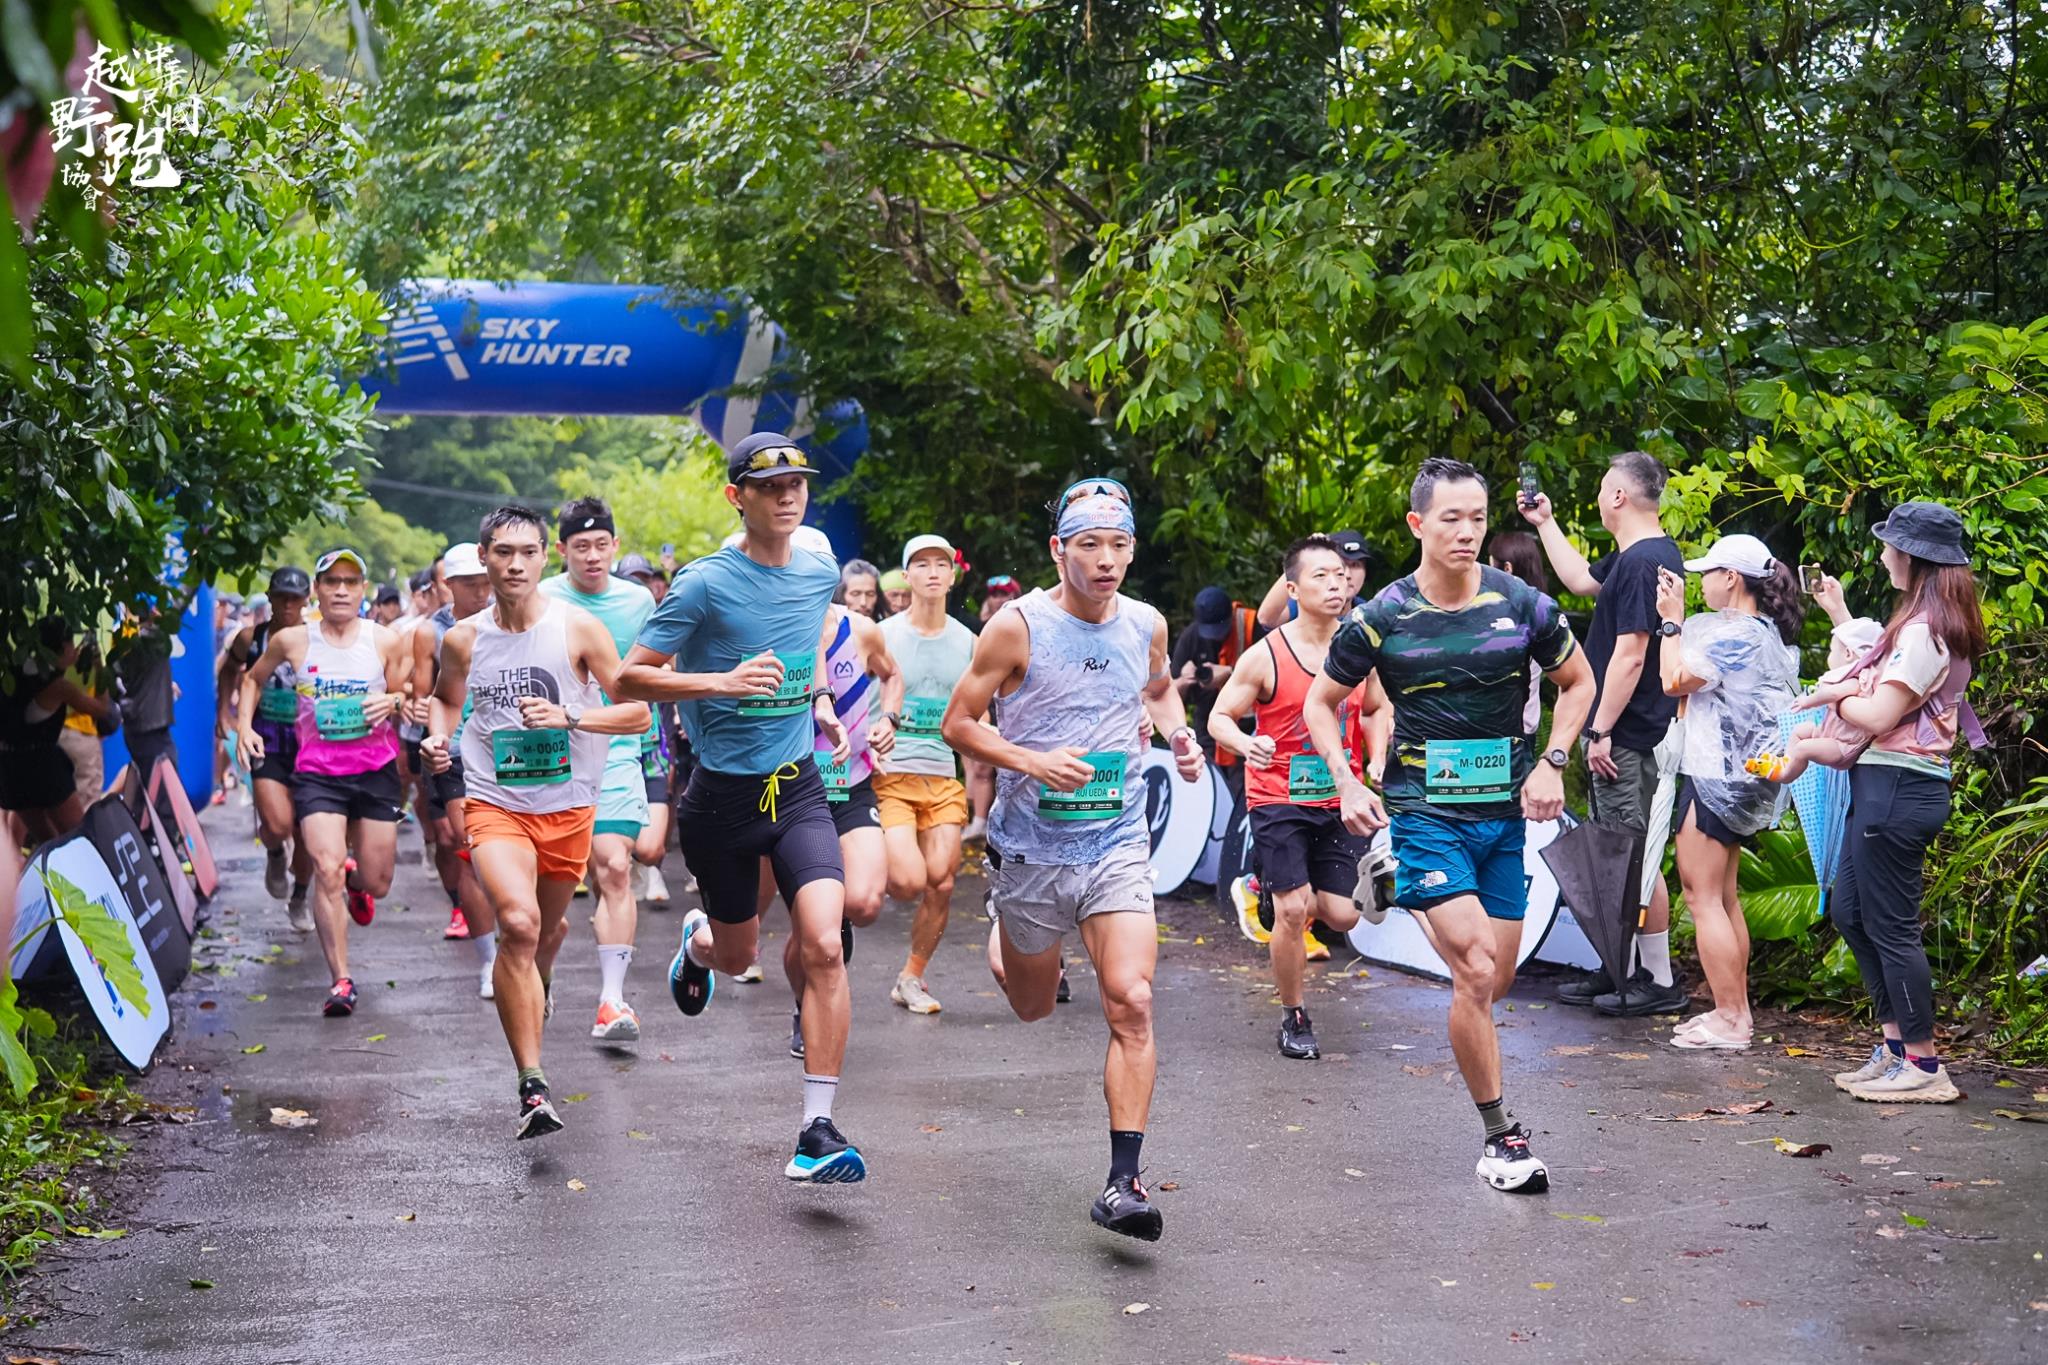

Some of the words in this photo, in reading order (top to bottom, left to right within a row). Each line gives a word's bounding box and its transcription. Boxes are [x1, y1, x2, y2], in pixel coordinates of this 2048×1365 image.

[480, 317, 560, 340] SKY
[480, 342, 631, 367] HUNTER
[499, 667, 529, 682] THE
[784, 666, 812, 682] -0003
[479, 681, 530, 698] NORTH
[493, 694, 521, 710] FAC
[523, 740, 566, 755] M-0002
[820, 764, 846, 775] 0060
[1459, 754, 1506, 774] M-0220
[1075, 788, 1088, 798] RUI
[1089, 787, 1107, 797] UEDA
